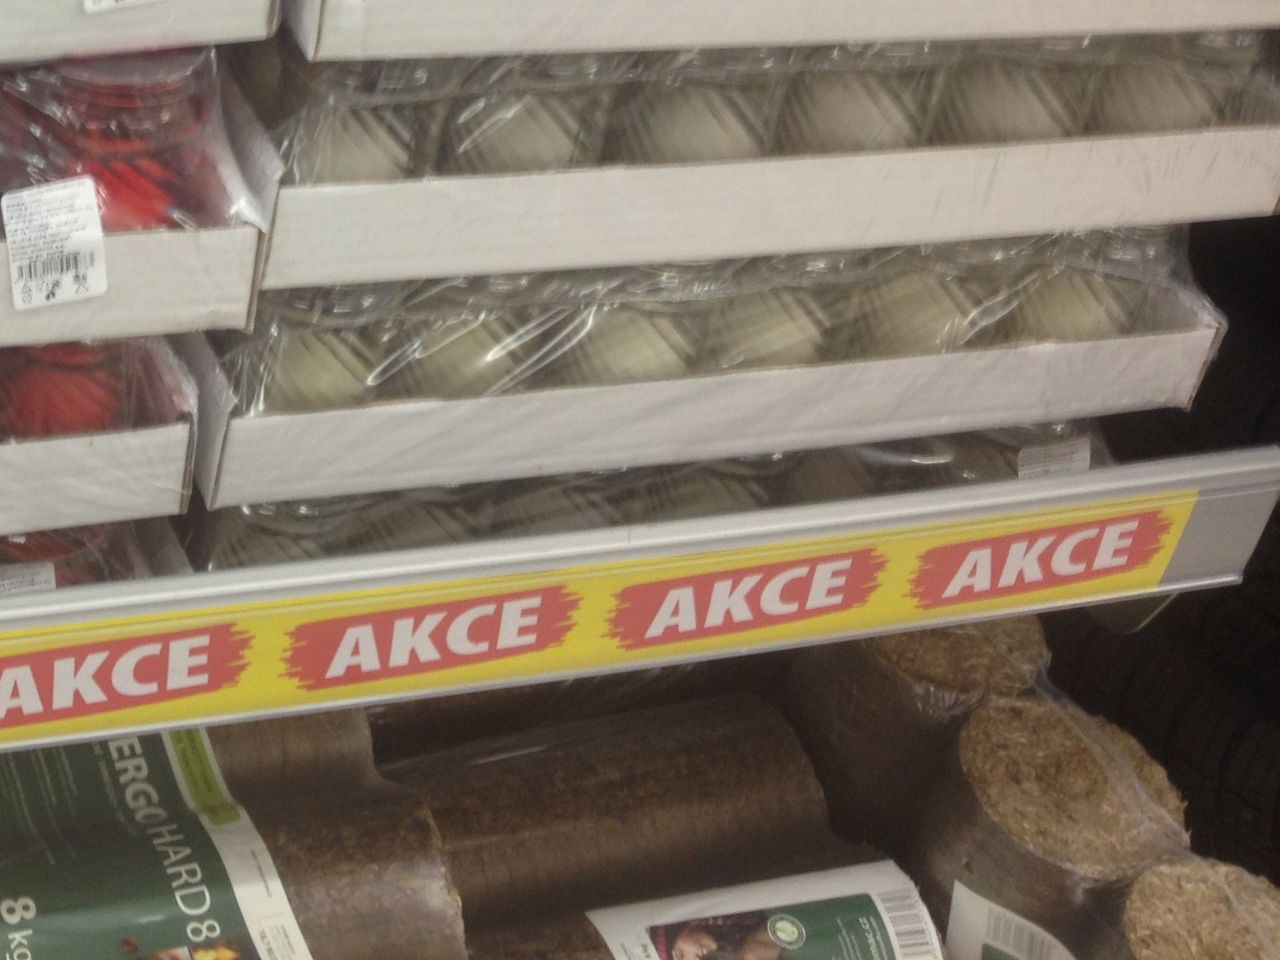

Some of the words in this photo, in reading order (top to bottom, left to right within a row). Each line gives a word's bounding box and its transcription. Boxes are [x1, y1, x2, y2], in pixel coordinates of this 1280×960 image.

[644, 556, 852, 638] AKCE
[940, 520, 1140, 598] AKCE
[325, 596, 543, 679] AKCE
[0, 896, 37, 926] 8
